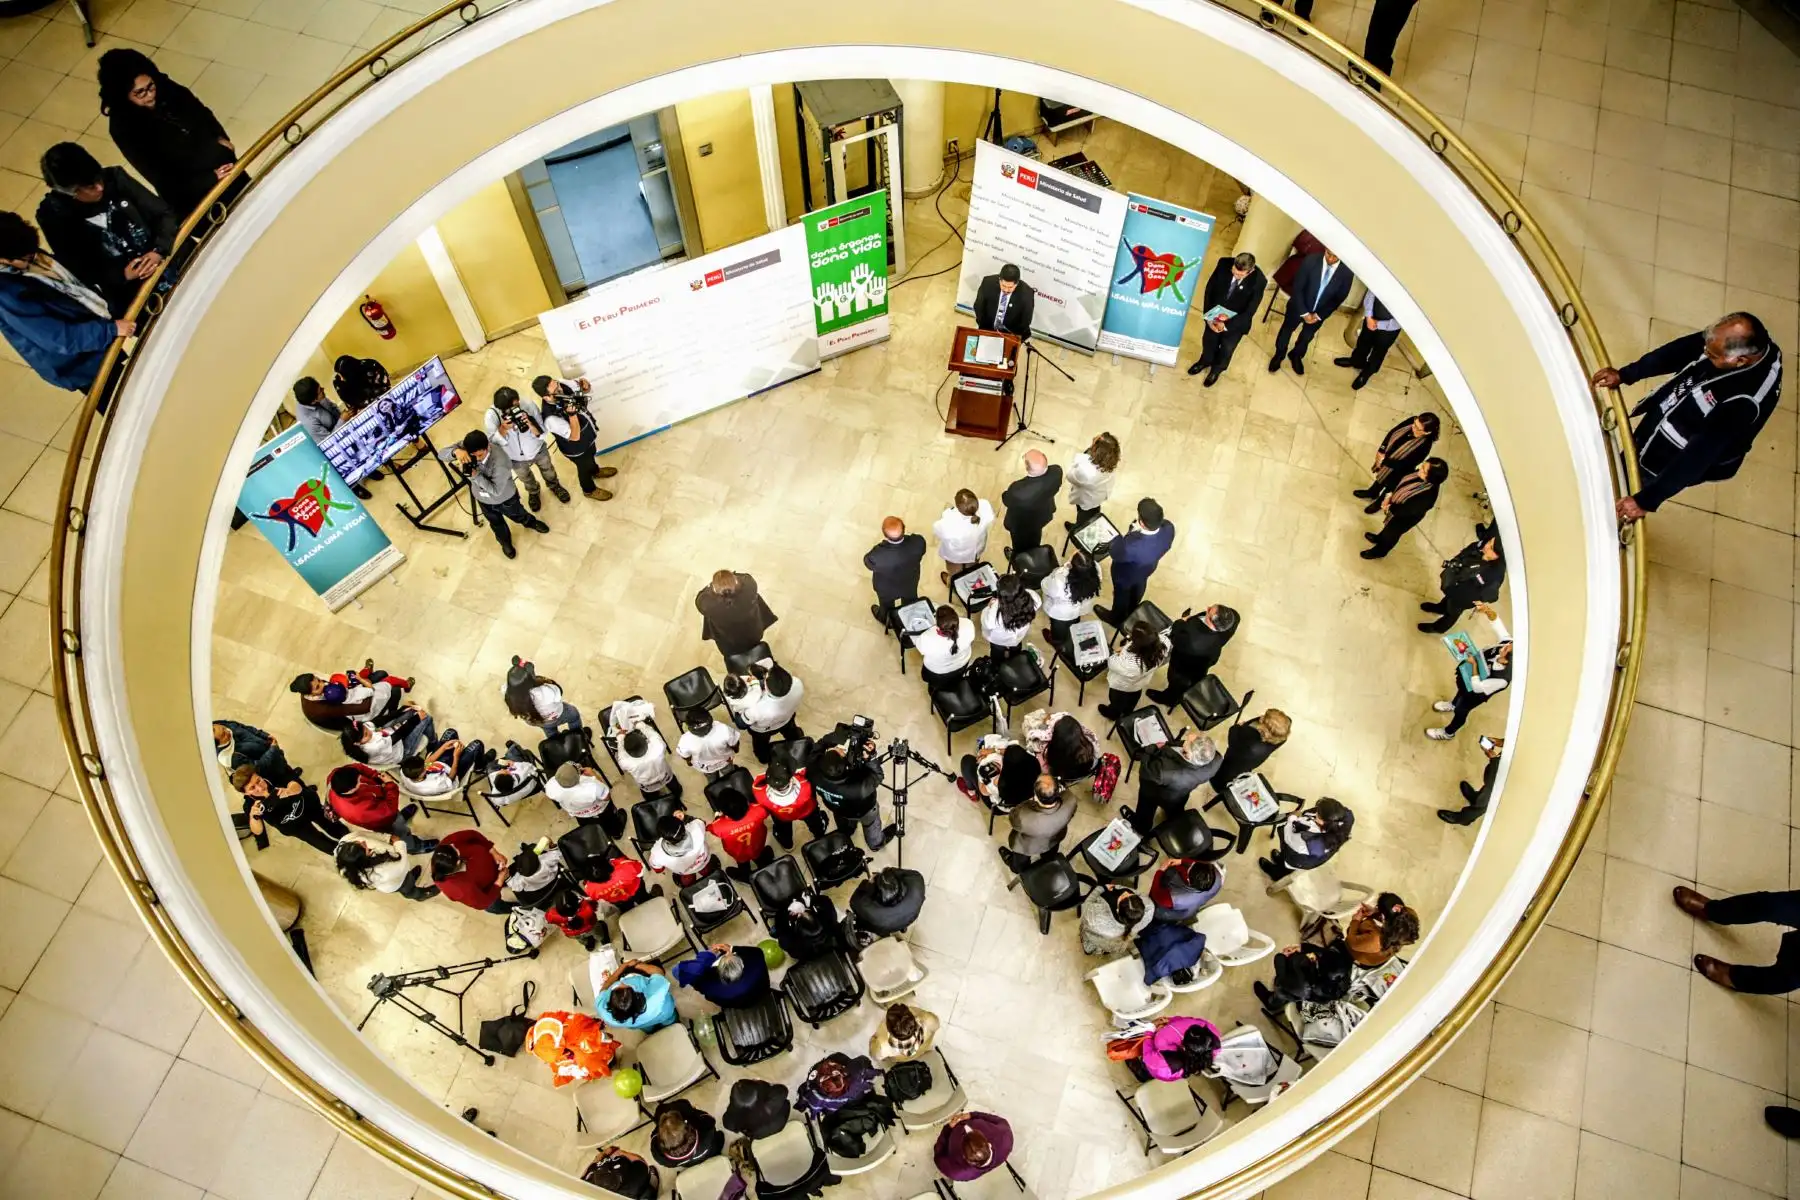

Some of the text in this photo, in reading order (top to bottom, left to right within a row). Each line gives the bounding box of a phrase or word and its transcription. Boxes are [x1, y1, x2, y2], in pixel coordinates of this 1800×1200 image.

[1040, 180, 1065, 194] Ministerio
[1073, 193, 1086, 202] Salud
[811, 247, 837, 259] dona
[812, 240, 882, 268] dona vida
[1141, 301, 1159, 310] UNA
[292, 498, 309, 512] Dona
[324, 531, 344, 544] UNA
[343, 512, 368, 531] VIDA!
